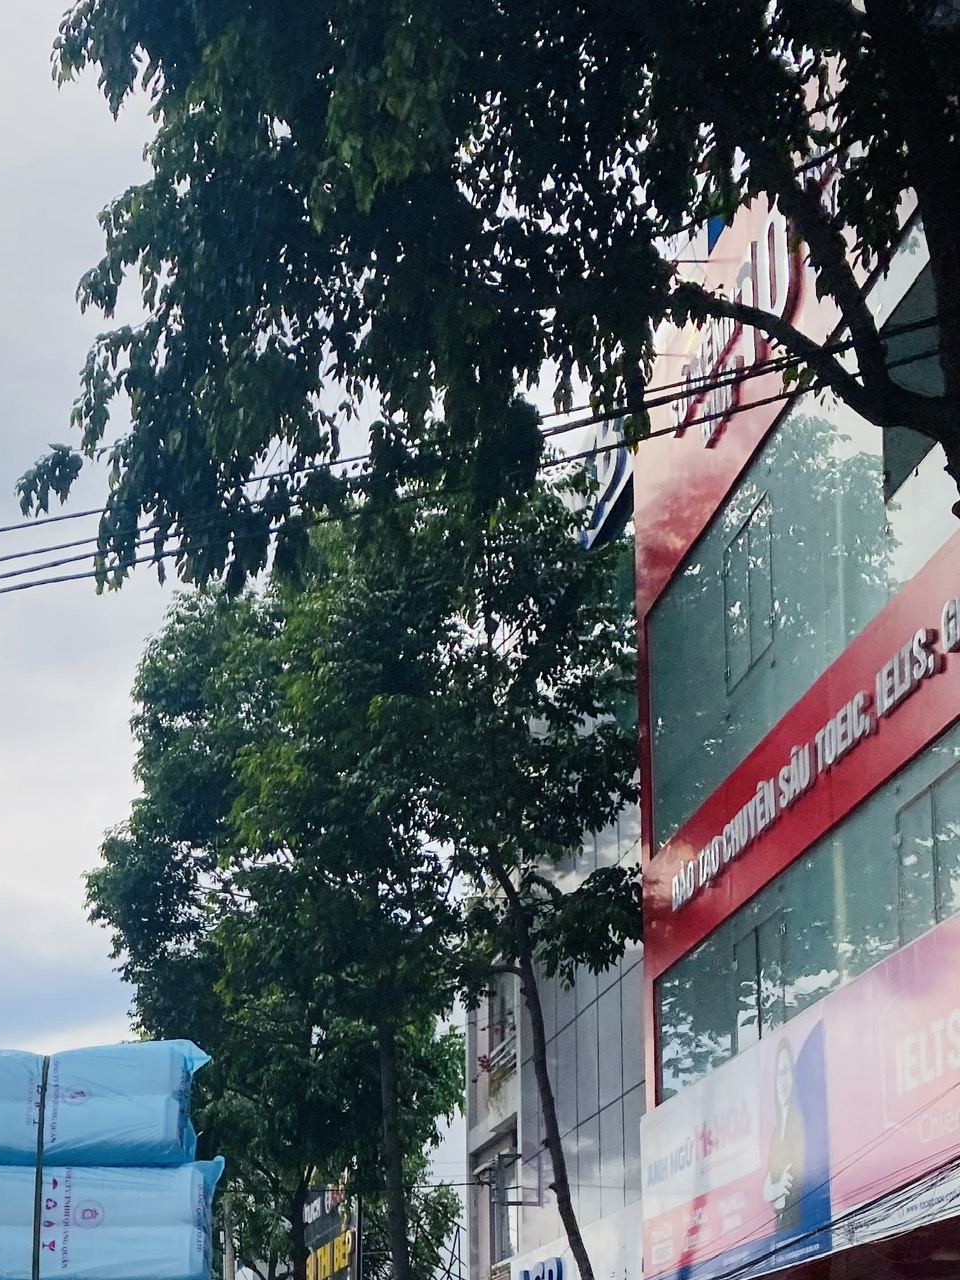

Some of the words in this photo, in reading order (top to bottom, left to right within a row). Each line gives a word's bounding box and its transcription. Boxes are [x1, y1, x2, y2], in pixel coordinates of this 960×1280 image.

[723, 778, 776, 863] CHUYÊN
[779, 743, 810, 808] SÂU
[815, 690, 872, 773] TOEIC,
[874, 627, 935, 718] IELTS,
[63, 1196, 71, 1217] TNHH
[62, 1218, 70, 1245] QUANG
